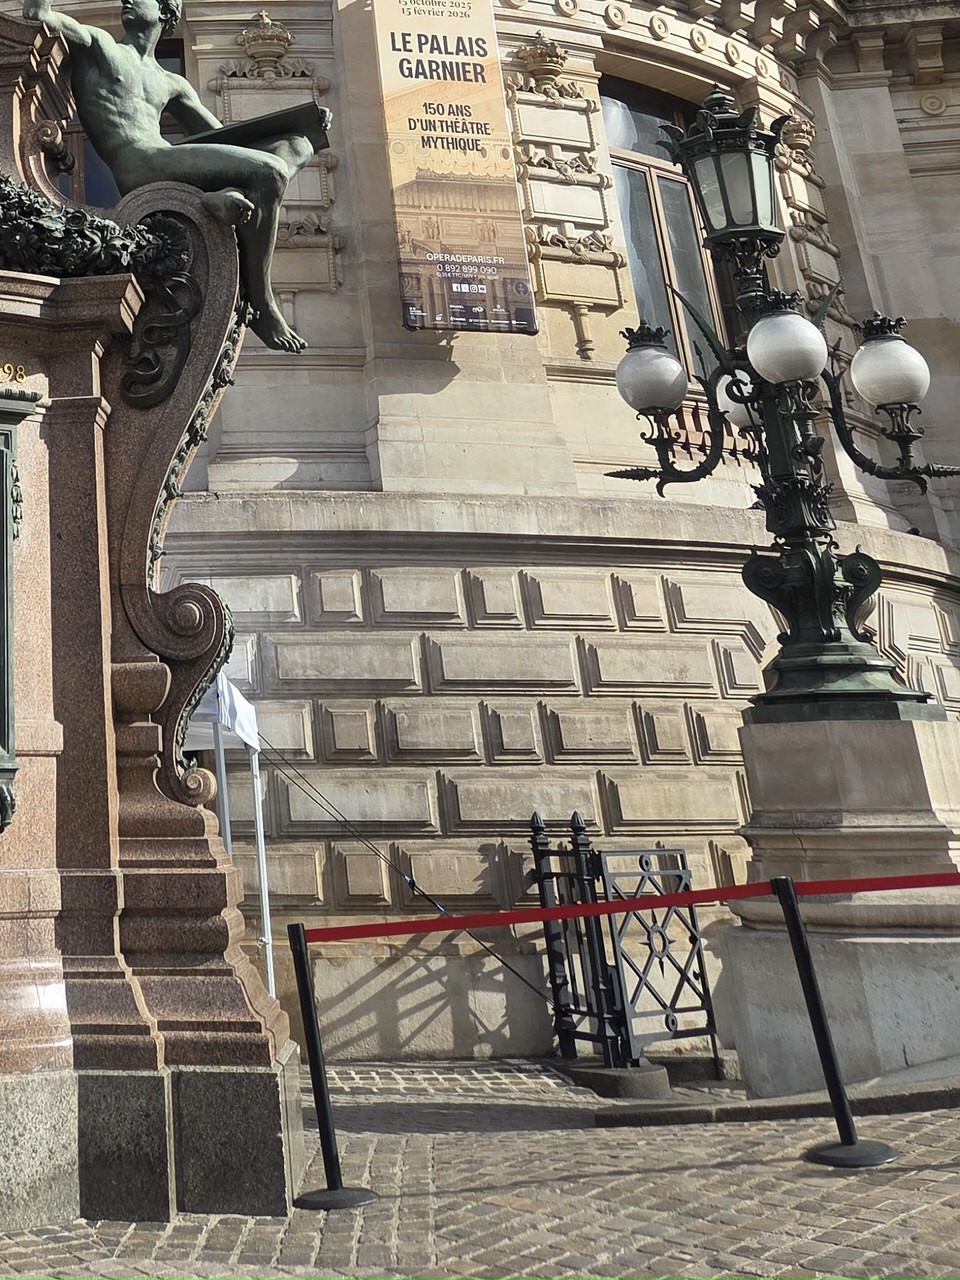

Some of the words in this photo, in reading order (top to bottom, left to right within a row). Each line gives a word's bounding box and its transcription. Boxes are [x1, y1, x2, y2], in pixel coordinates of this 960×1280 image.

[401, 7, 411, 16] 15
[413, 6, 445, 17] février
[447, 10, 471, 19] 2026
[449, 0, 472, 11] 2025
[390, 32, 413, 53] LE
[417, 33, 488, 58] PALAIS
[398, 58, 487, 83] GARNIER
[422, 102, 445, 116] 150
[447, 103, 472, 118] ANS
[408, 118, 437, 132] D'UN
[438, 117, 491, 135] THÉÂTRE
[421, 135, 483, 152] MYTHIQUE
[426, 252, 505, 265] OPERADEPARIS.FR
[436, 264, 443, 272] 0
[445, 264, 461, 273] 892
[462, 265, 478, 274] 899
[480, 266, 497, 275] 090
